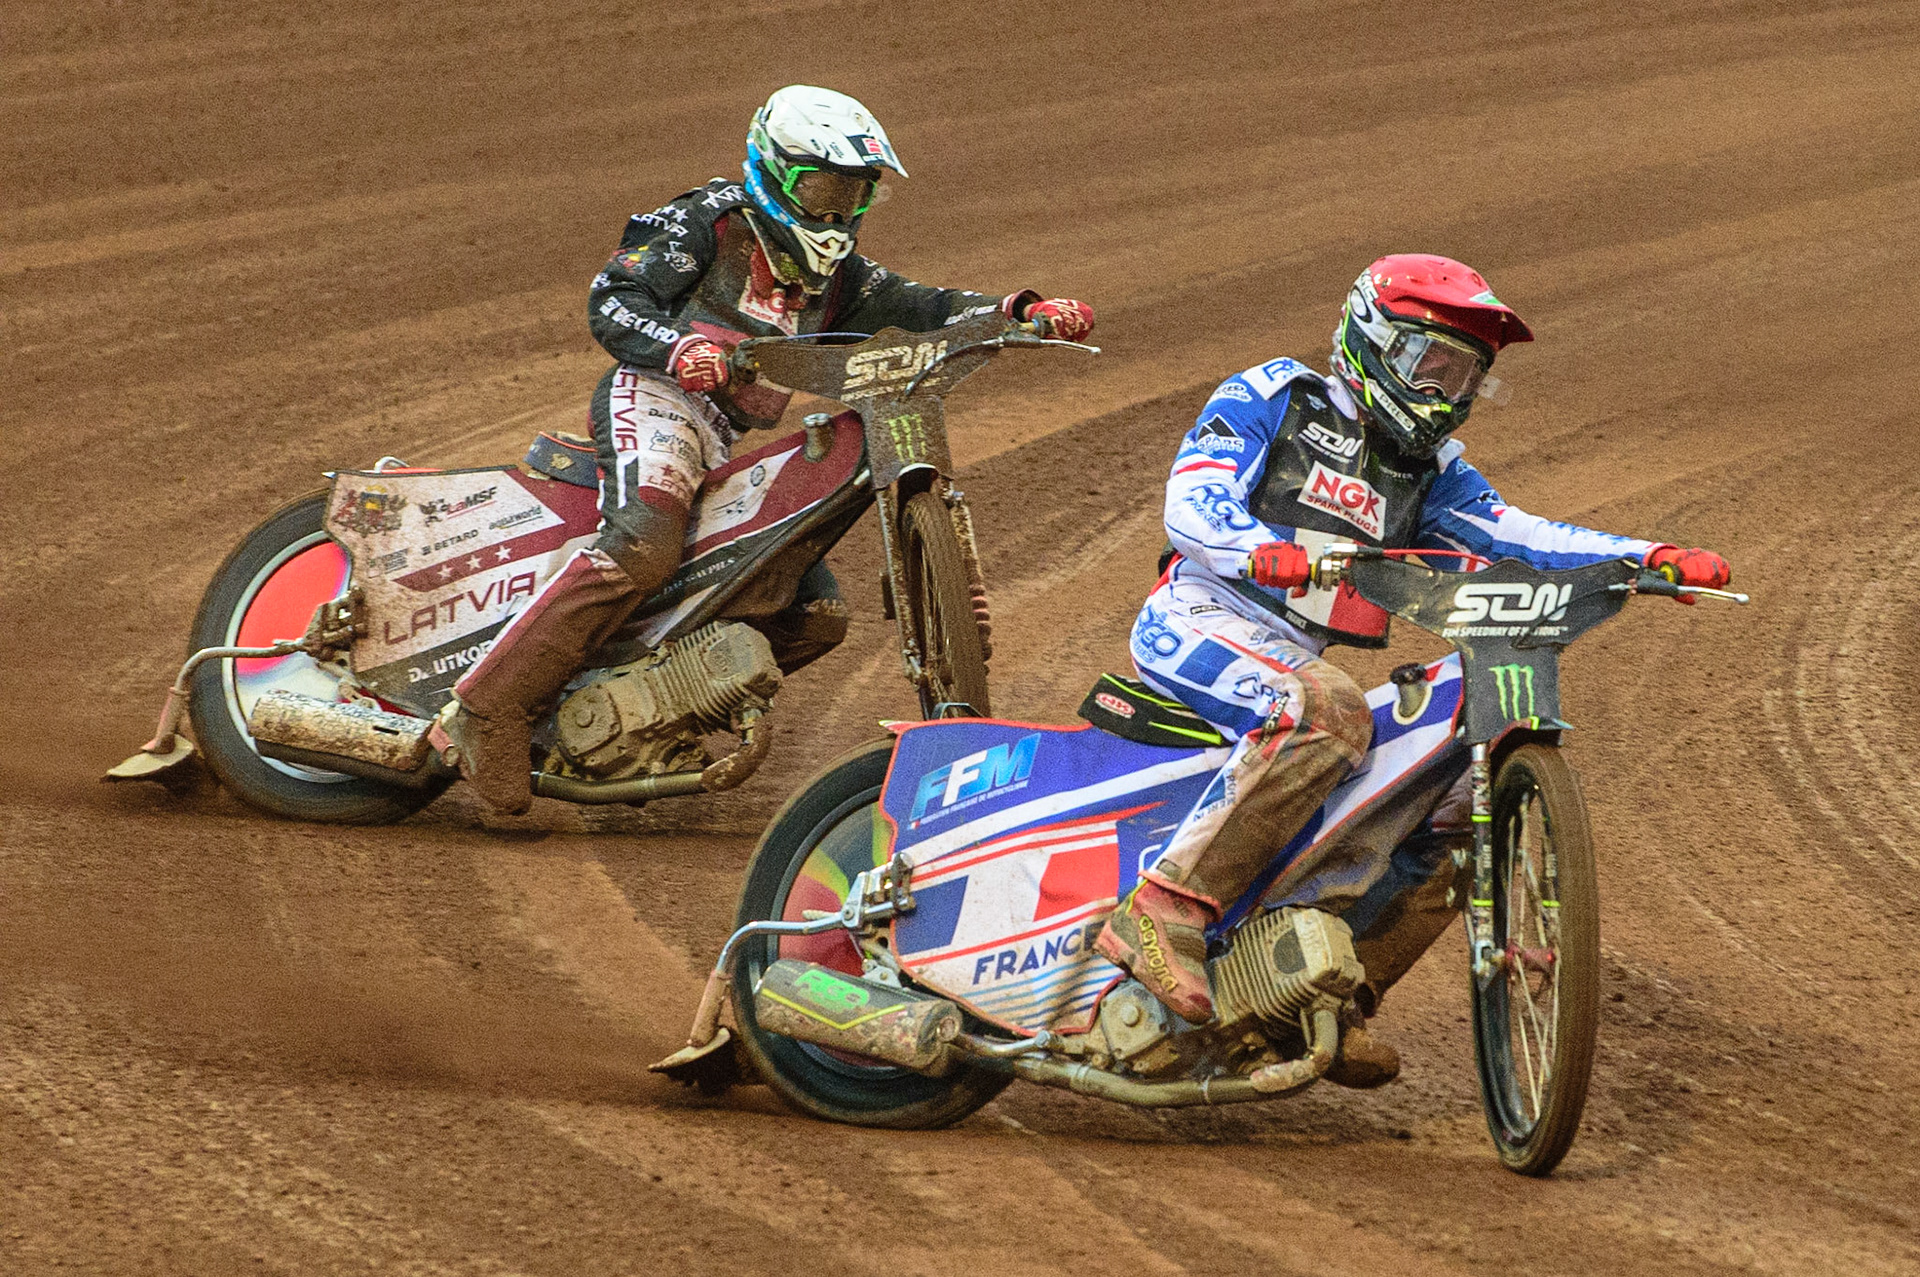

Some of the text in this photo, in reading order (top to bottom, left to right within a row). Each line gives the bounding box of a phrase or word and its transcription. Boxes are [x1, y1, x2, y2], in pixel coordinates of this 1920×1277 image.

[1306, 494, 1379, 535] SPARK PLUGS
[1311, 468, 1380, 522] NGK
[434, 529, 479, 551] BETARD
[383, 571, 536, 646] LATVIA
[1459, 626, 1509, 637] SPEEDWAY
[1507, 626, 1520, 637] OF
[909, 732, 1042, 821] FFM
